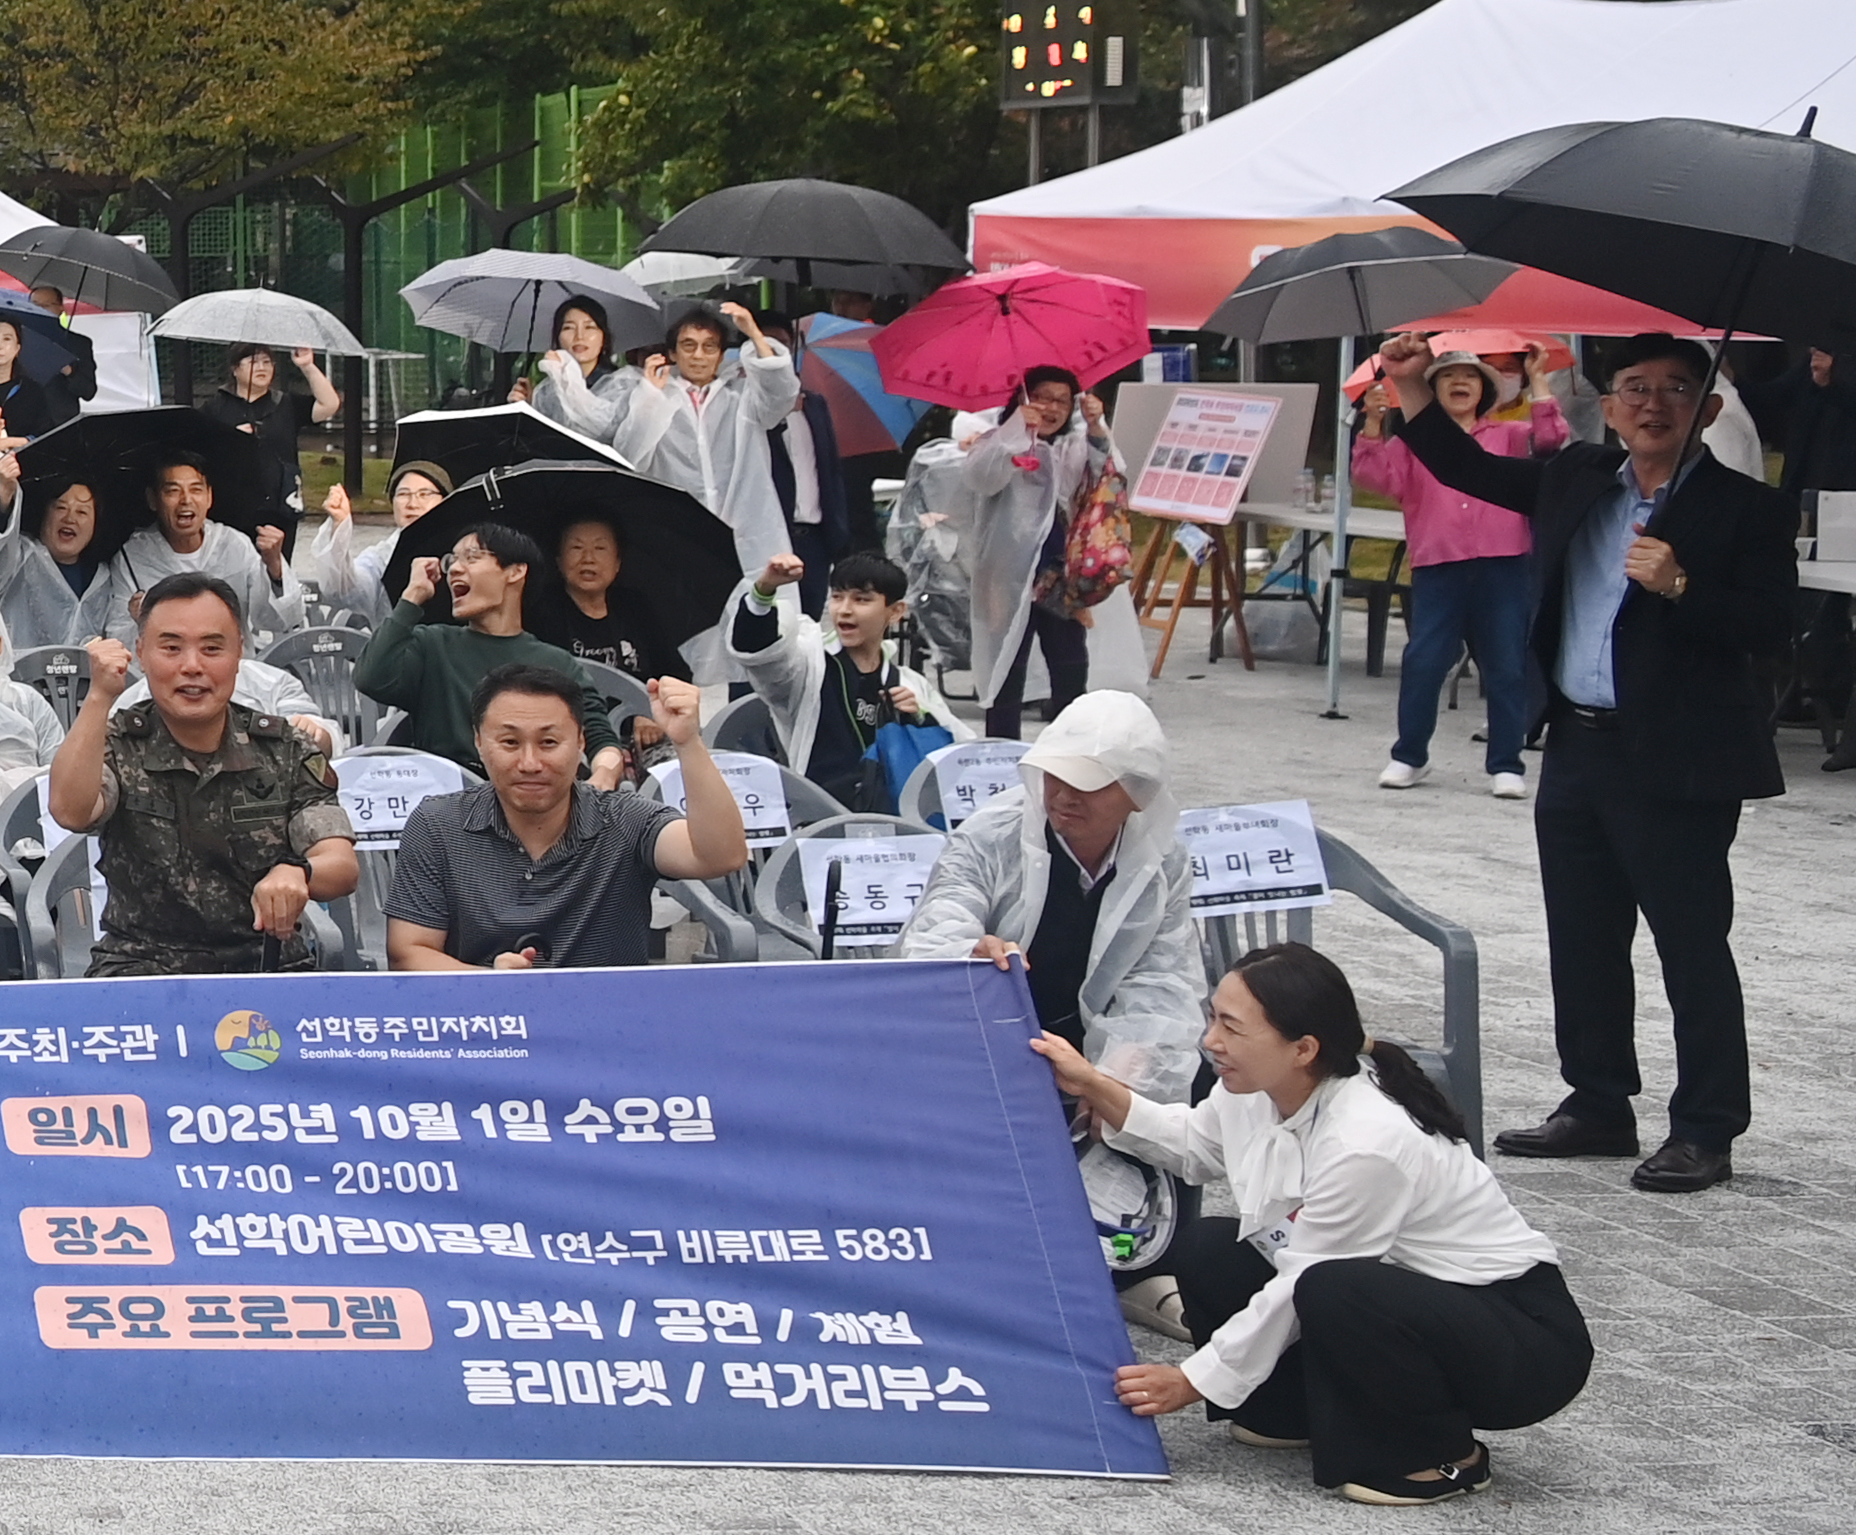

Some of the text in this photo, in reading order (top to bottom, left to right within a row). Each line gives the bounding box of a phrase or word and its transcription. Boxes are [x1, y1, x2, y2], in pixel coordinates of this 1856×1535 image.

[295, 1014, 529, 1044] 선학동주민자치회
[299, 1047, 389, 1061] Seonhak-dong
[457, 1046, 530, 1059] Association
[27, 1103, 130, 1149] 일시
[166, 1095, 717, 1145] 2025년 10월 1일 수요일
[46, 1215, 153, 1256] 장소
[189, 1213, 536, 1259] 선학어린이공원
[676, 1228, 830, 1264] 비류대로
[834, 1226, 933, 1261] 583]
[65, 1292, 401, 1341] 주요 프로그램
[453, 1300, 605, 1341] 기념식
[652, 1299, 763, 1345] 공연
[808, 1310, 925, 1346] 체험
[461, 1358, 673, 1408] 플리마켓
[721, 1360, 991, 1413] 먹거리부스
